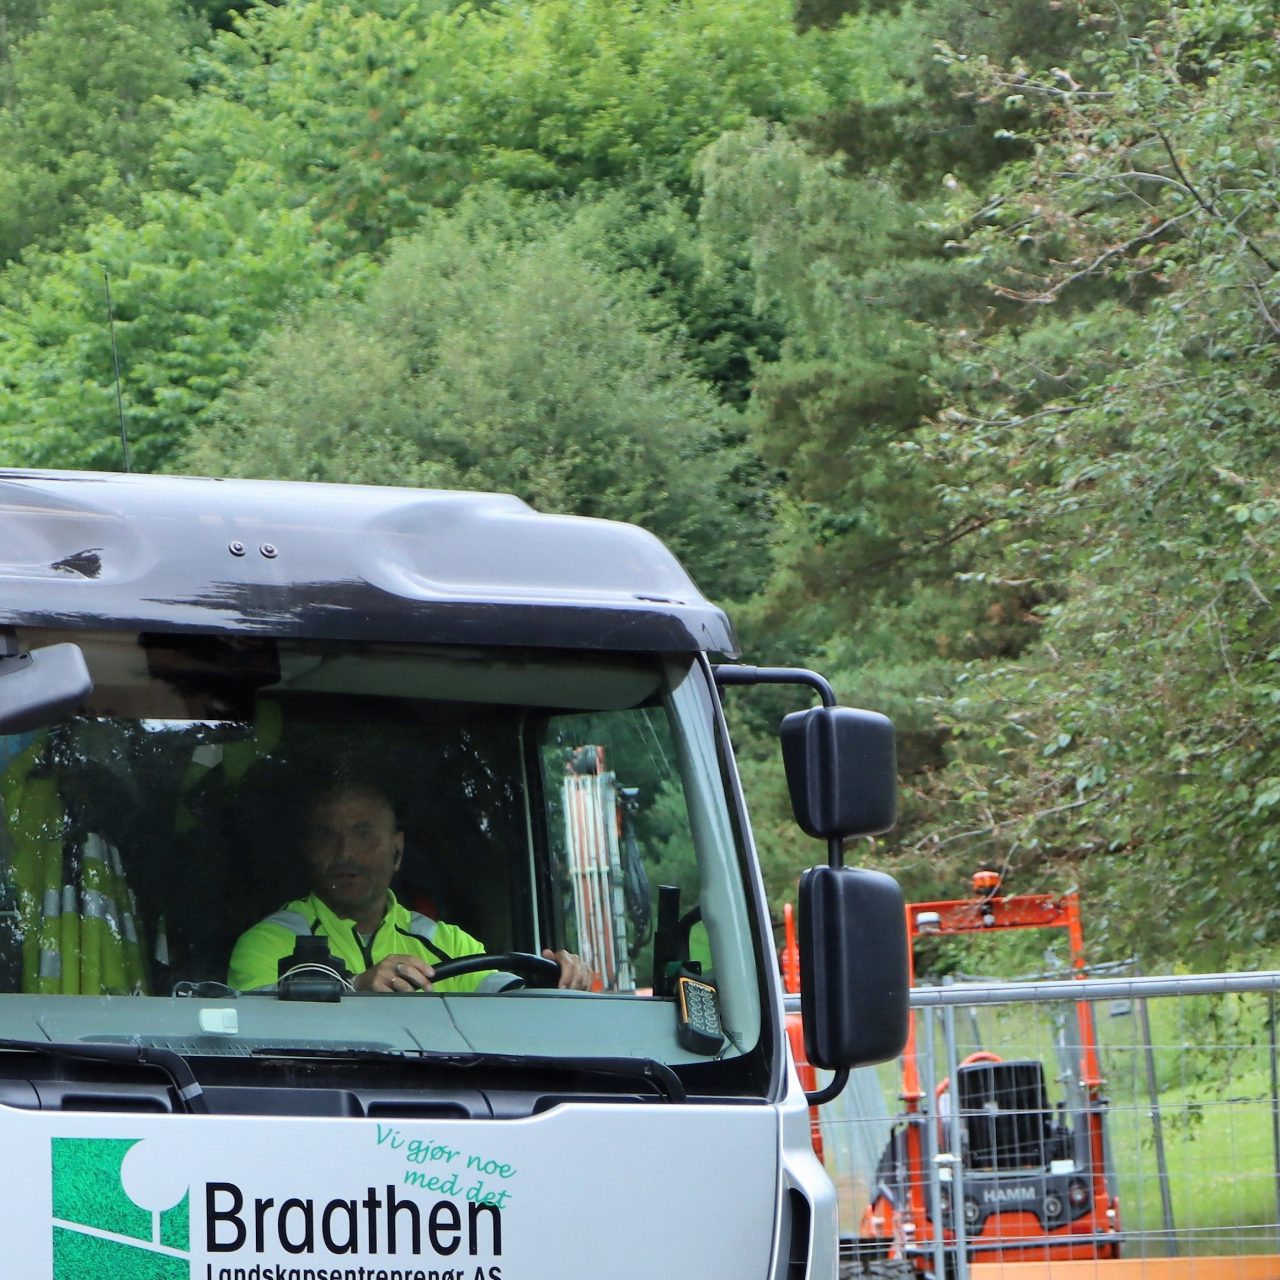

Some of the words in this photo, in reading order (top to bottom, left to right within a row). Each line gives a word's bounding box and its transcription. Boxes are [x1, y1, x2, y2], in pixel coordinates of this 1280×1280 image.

[376, 1123, 406, 1149] Vi
[406, 1139, 460, 1164] gjør
[466, 1154, 517, 1179] noe
[403, 1169, 463, 1197] med
[465, 1180, 513, 1210] det
[982, 1187, 1036, 1202] HAMM
[206, 1182, 503, 1256] Braathen
